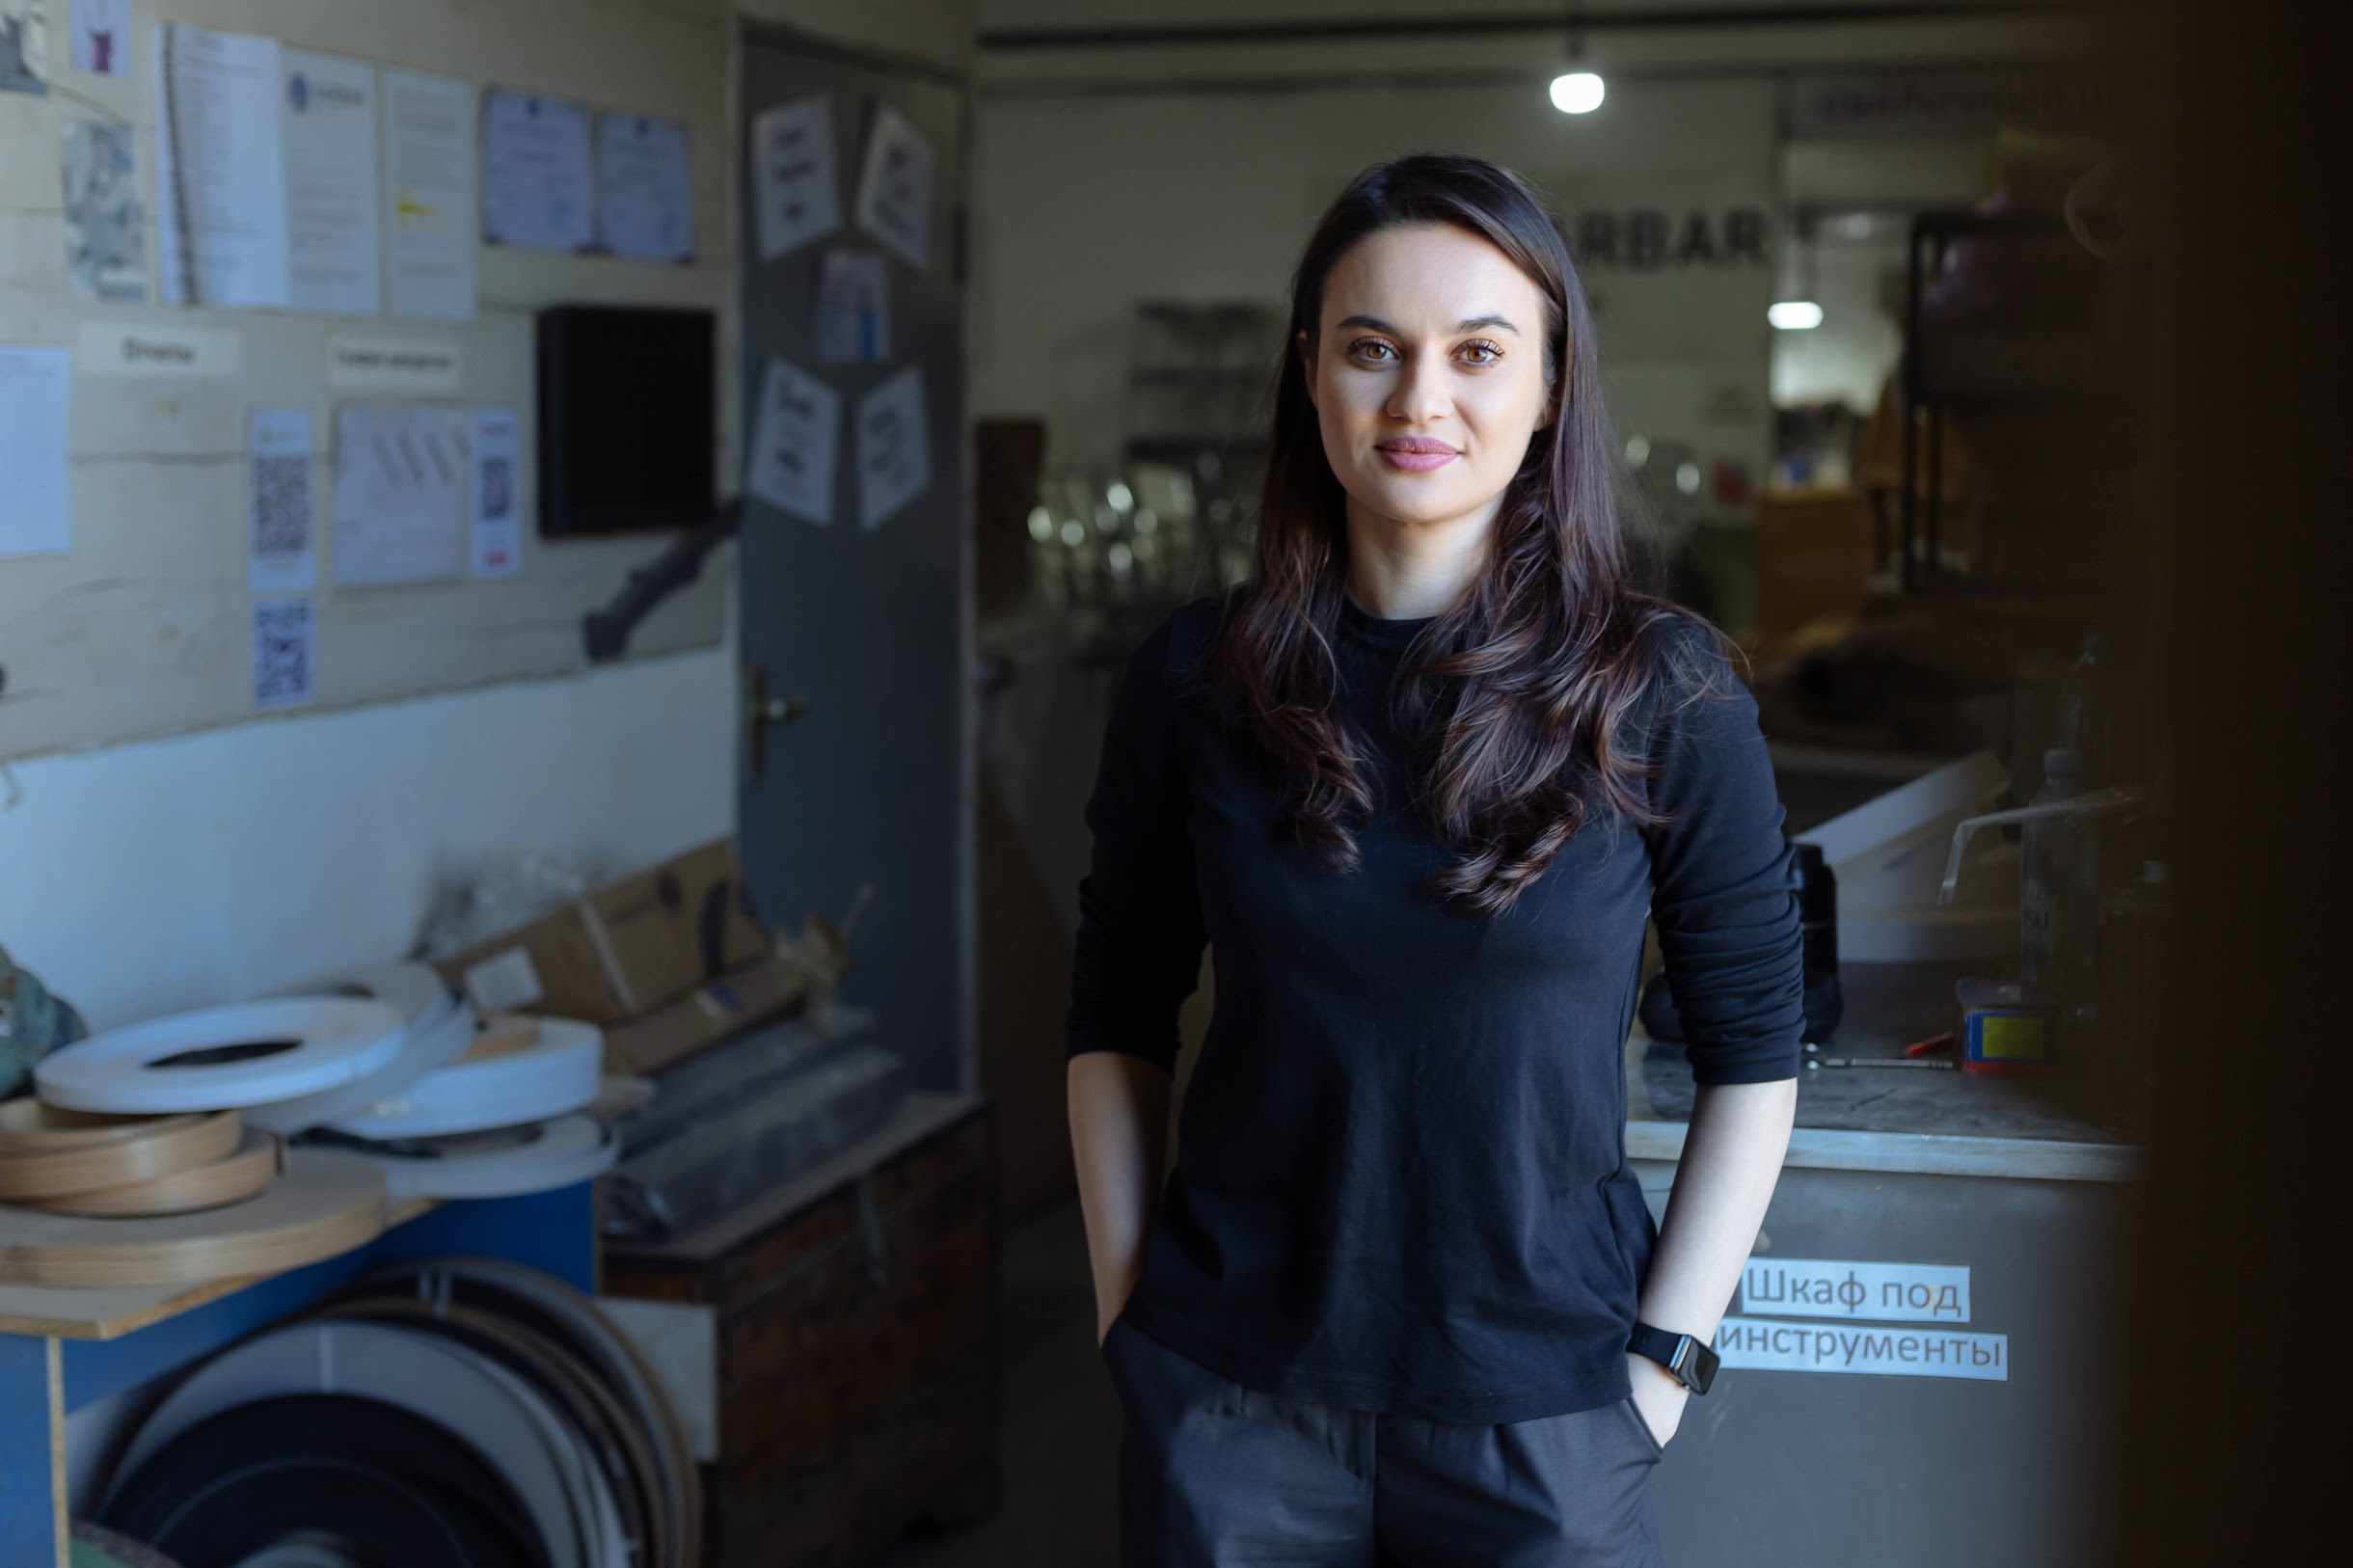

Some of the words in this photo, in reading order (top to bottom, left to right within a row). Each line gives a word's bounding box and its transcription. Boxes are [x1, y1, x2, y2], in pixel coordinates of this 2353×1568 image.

[1747, 1268, 1866, 1313] Шкаф
[1881, 1283, 1961, 1317] под
[1719, 1325, 2001, 1366] инструменты
